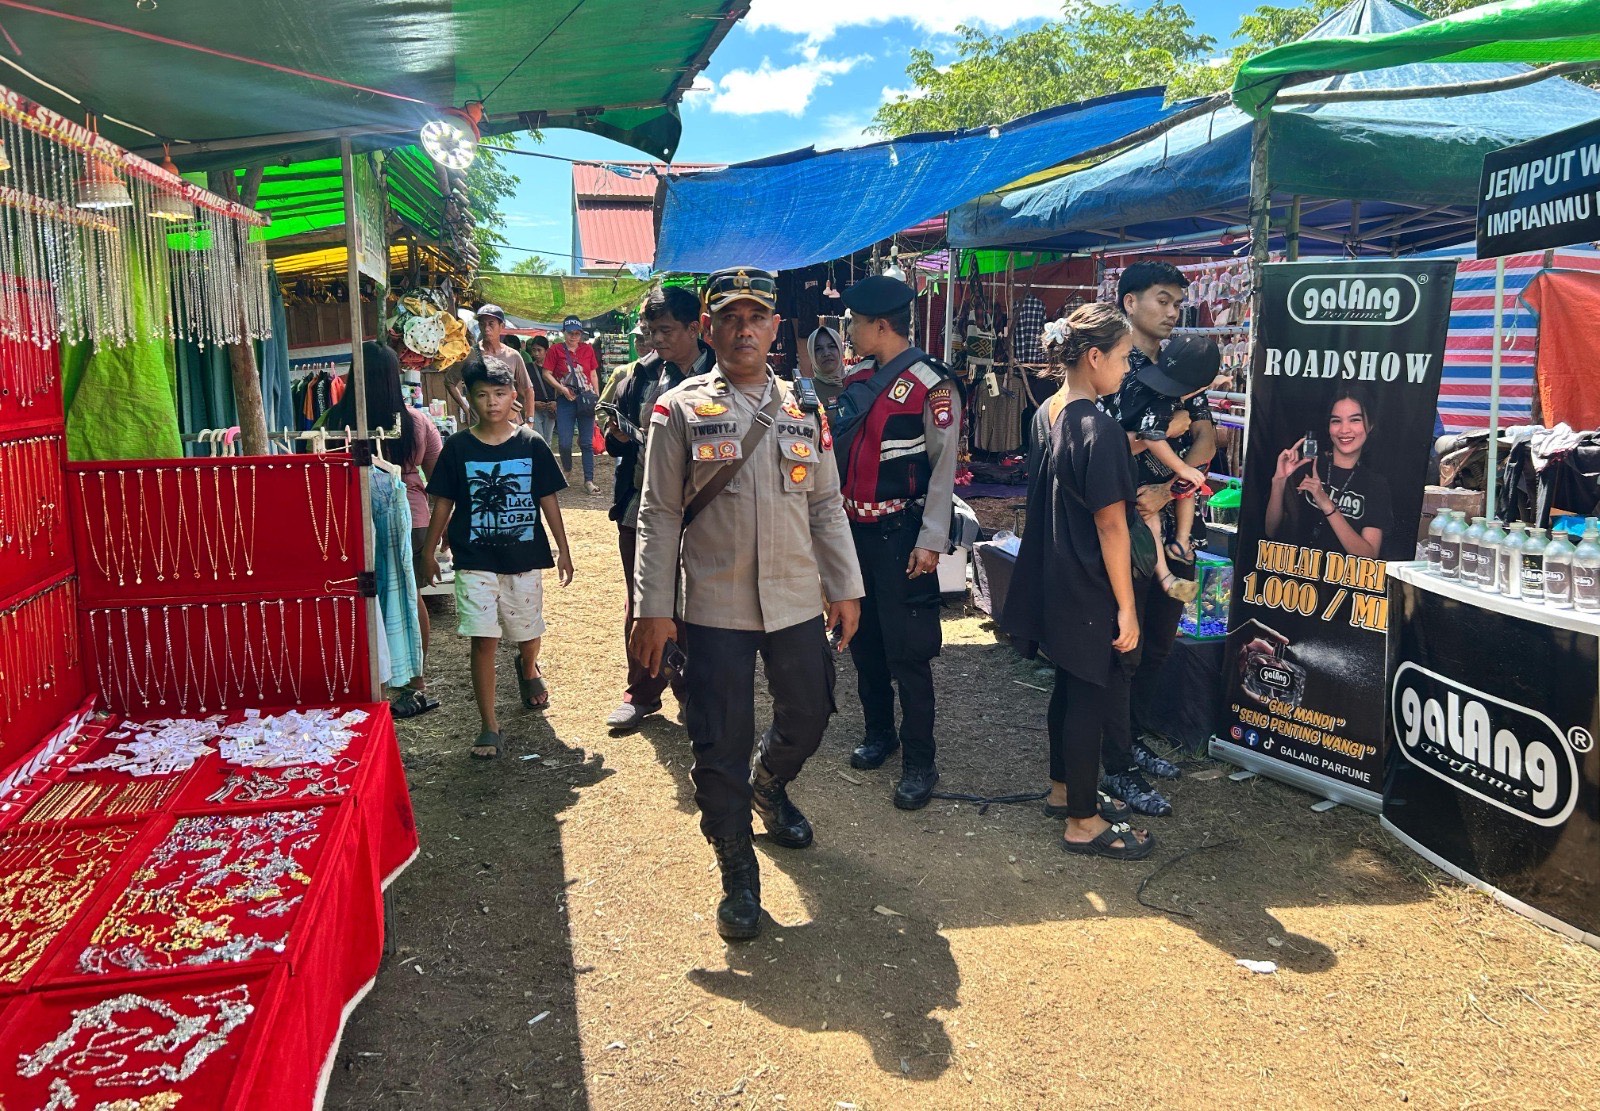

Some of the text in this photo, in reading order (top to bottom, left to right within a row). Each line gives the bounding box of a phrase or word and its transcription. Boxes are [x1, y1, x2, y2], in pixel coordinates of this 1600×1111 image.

[1485, 150, 1576, 201] JEMPUT
[187, 184, 230, 209] STAINLESS
[1487, 193, 1590, 237] IMPIANMU
[1319, 309, 1382, 321] Perfume
[1263, 348, 1432, 384] ROADSHOW
[778, 424, 814, 439] POLRI
[1256, 540, 1387, 592] MULAI DARI
[1243, 572, 1318, 616] 1.000
[1321, 589, 1347, 621] /
[1269, 717, 1321, 744] PENTING
[1280, 745, 1371, 783] GALANG PARFUME
[1420, 742, 1529, 799] Perfume
